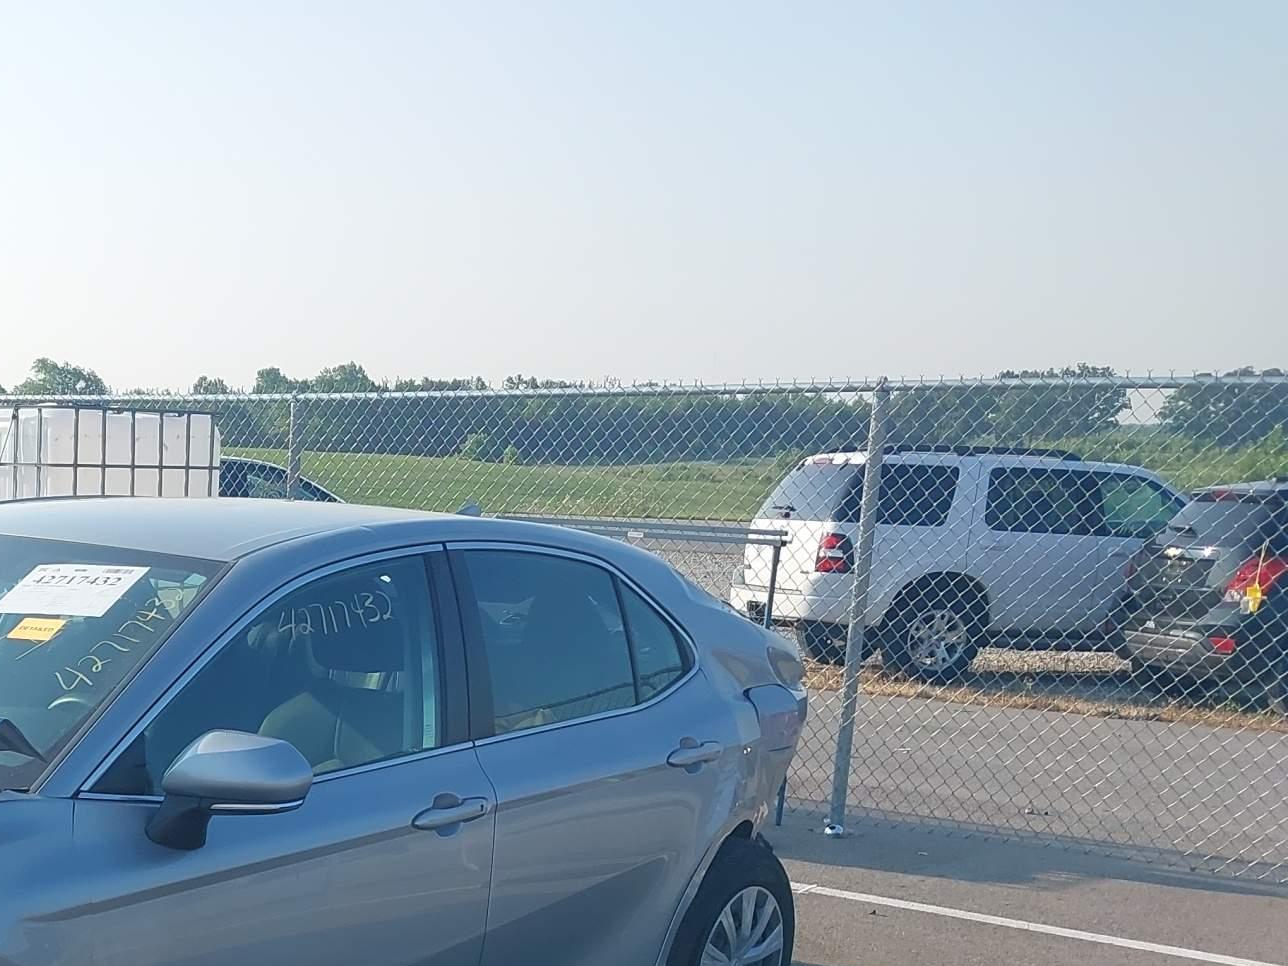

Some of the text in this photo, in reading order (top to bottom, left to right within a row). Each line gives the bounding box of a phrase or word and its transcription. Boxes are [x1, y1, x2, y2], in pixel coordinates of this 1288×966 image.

[32, 575, 123, 586] 42717432
[55, 588, 183, 690] 42717432
[278, 590, 393, 641] 42717432
